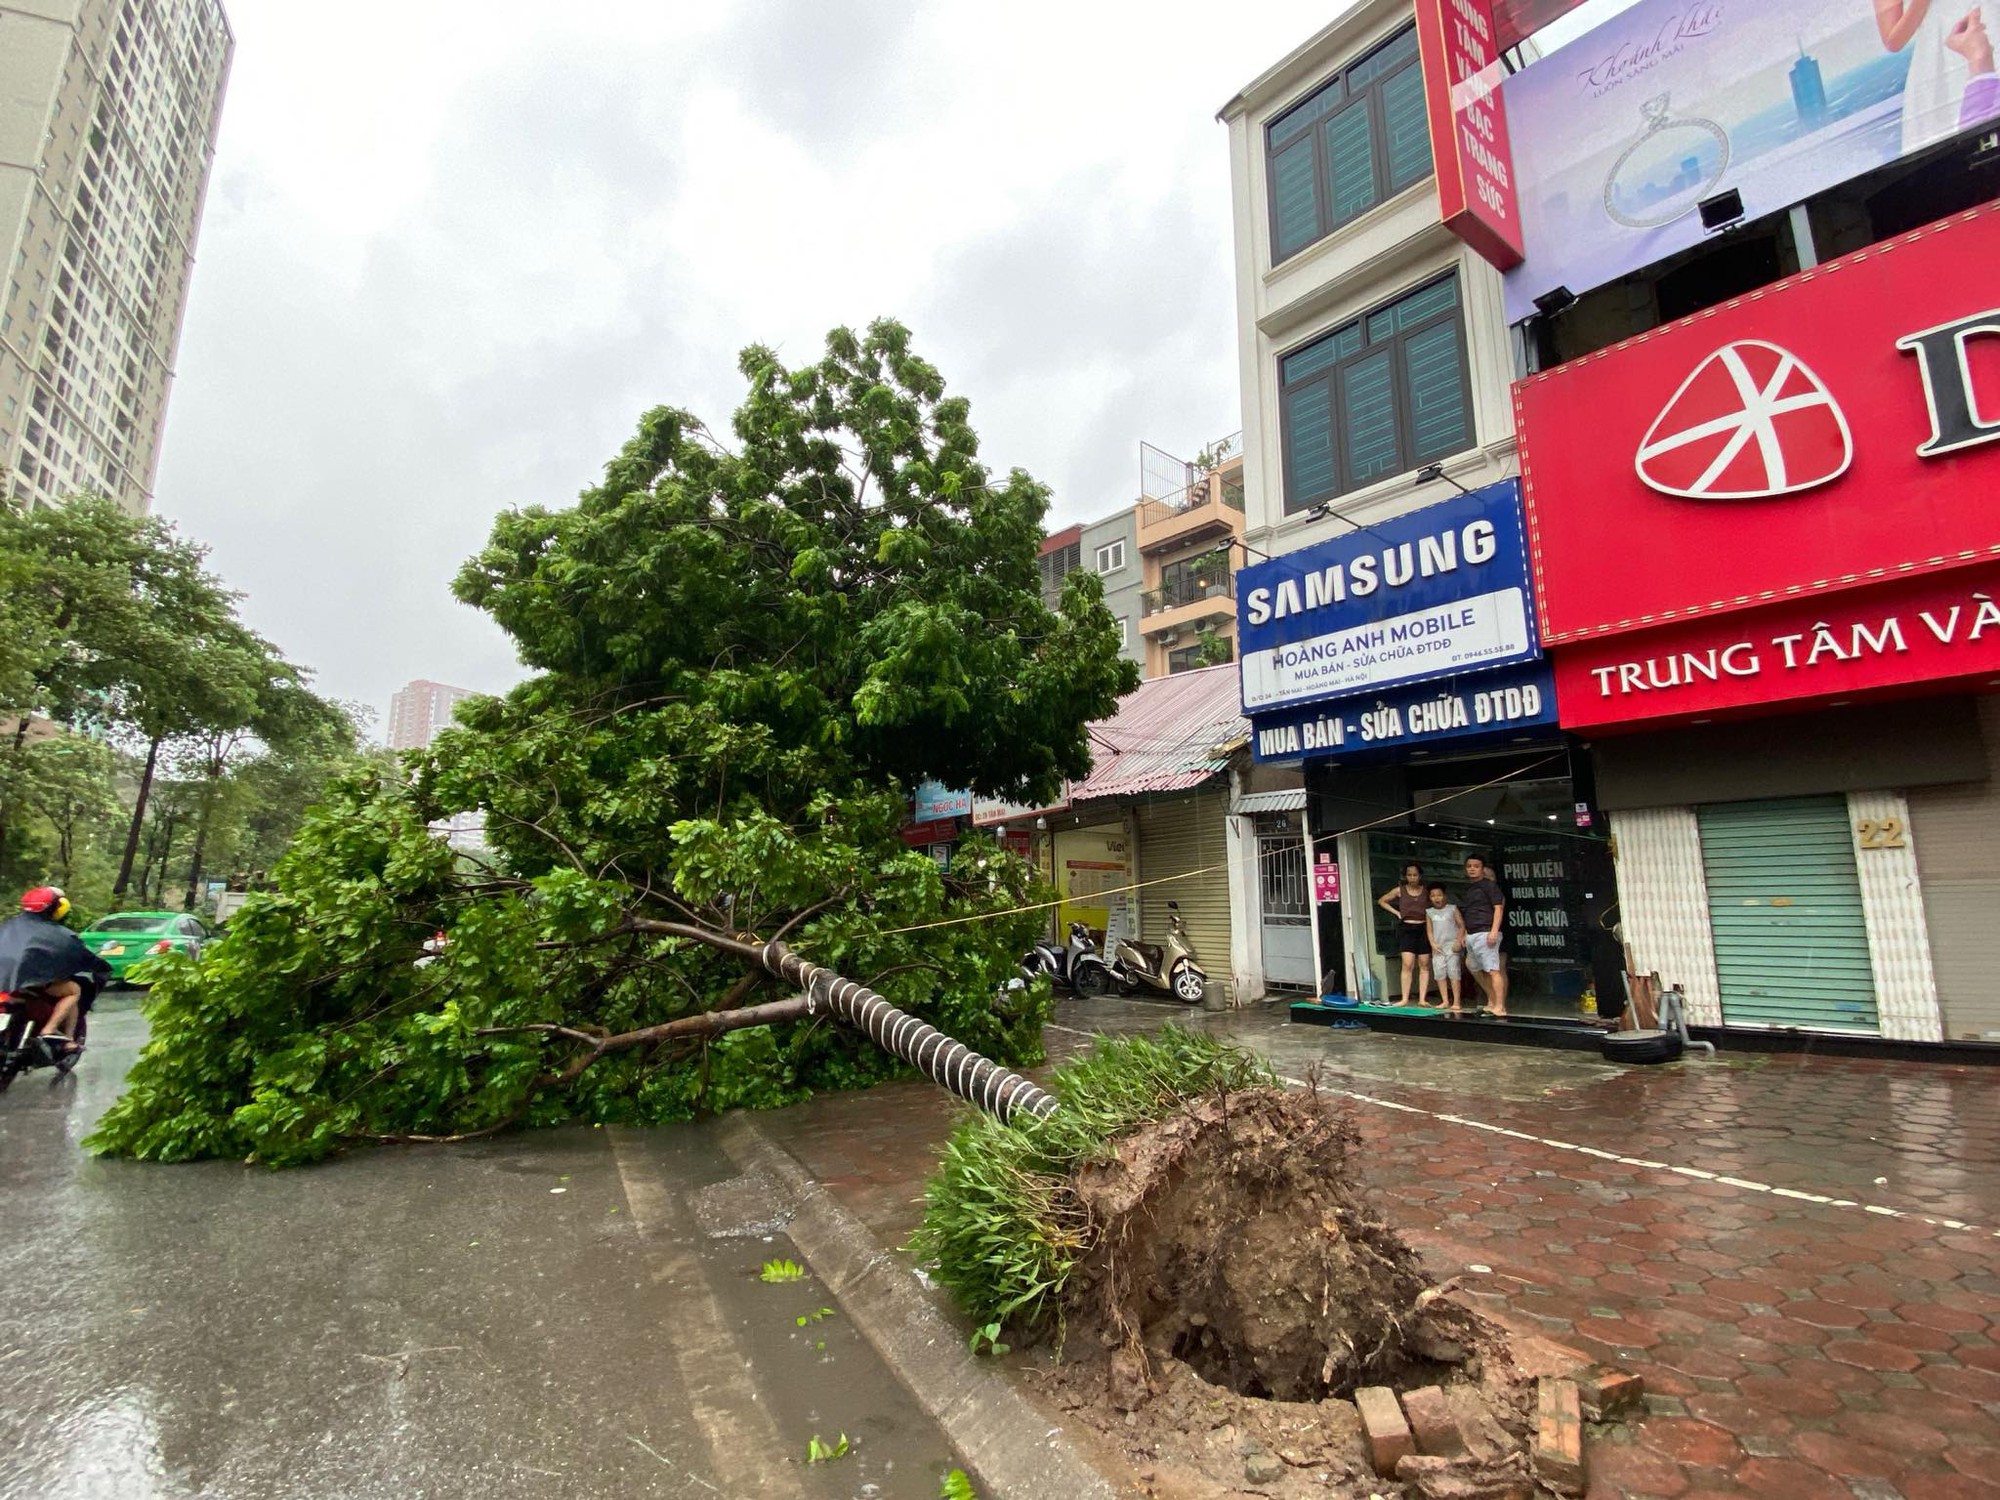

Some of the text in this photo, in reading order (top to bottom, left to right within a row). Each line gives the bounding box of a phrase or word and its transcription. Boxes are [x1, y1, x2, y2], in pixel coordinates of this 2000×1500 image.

[1465, 93, 1495, 142] BẠC
[1461, 124, 1509, 190] TRANG
[1476, 173, 1506, 219] SỨC
[1246, 519, 1497, 625] SAMSUNG
[1272, 608, 1476, 670] HOÀNG ANH MOBILE
[1294, 669, 1320, 681] MUA
[1321, 662, 1344, 675] BÁN
[1353, 651, 1377, 668] SỬA
[1380, 645, 1414, 662] CHỮA
[1417, 638, 1452, 655] ĐTDĐ
[1591, 642, 1761, 697] TRUNG
[1772, 616, 1908, 669] TÂM
[1259, 725, 1301, 756] MUA
[1302, 714, 1345, 750] BÁN
[1361, 700, 1404, 741] SỬA
[1408, 692, 1469, 734] CHỮA
[1474, 684, 1541, 724] ĐTDĐ
[1276, 820, 1287, 828] 26
[1857, 816, 1905, 849] 22
[1503, 858, 1564, 882] PHỤ KIỆN
[1511, 887, 1535, 899] MUA
[1508, 905, 1569, 928] SỬA CHỮA
[1538, 934, 1565, 949] THOẠI
